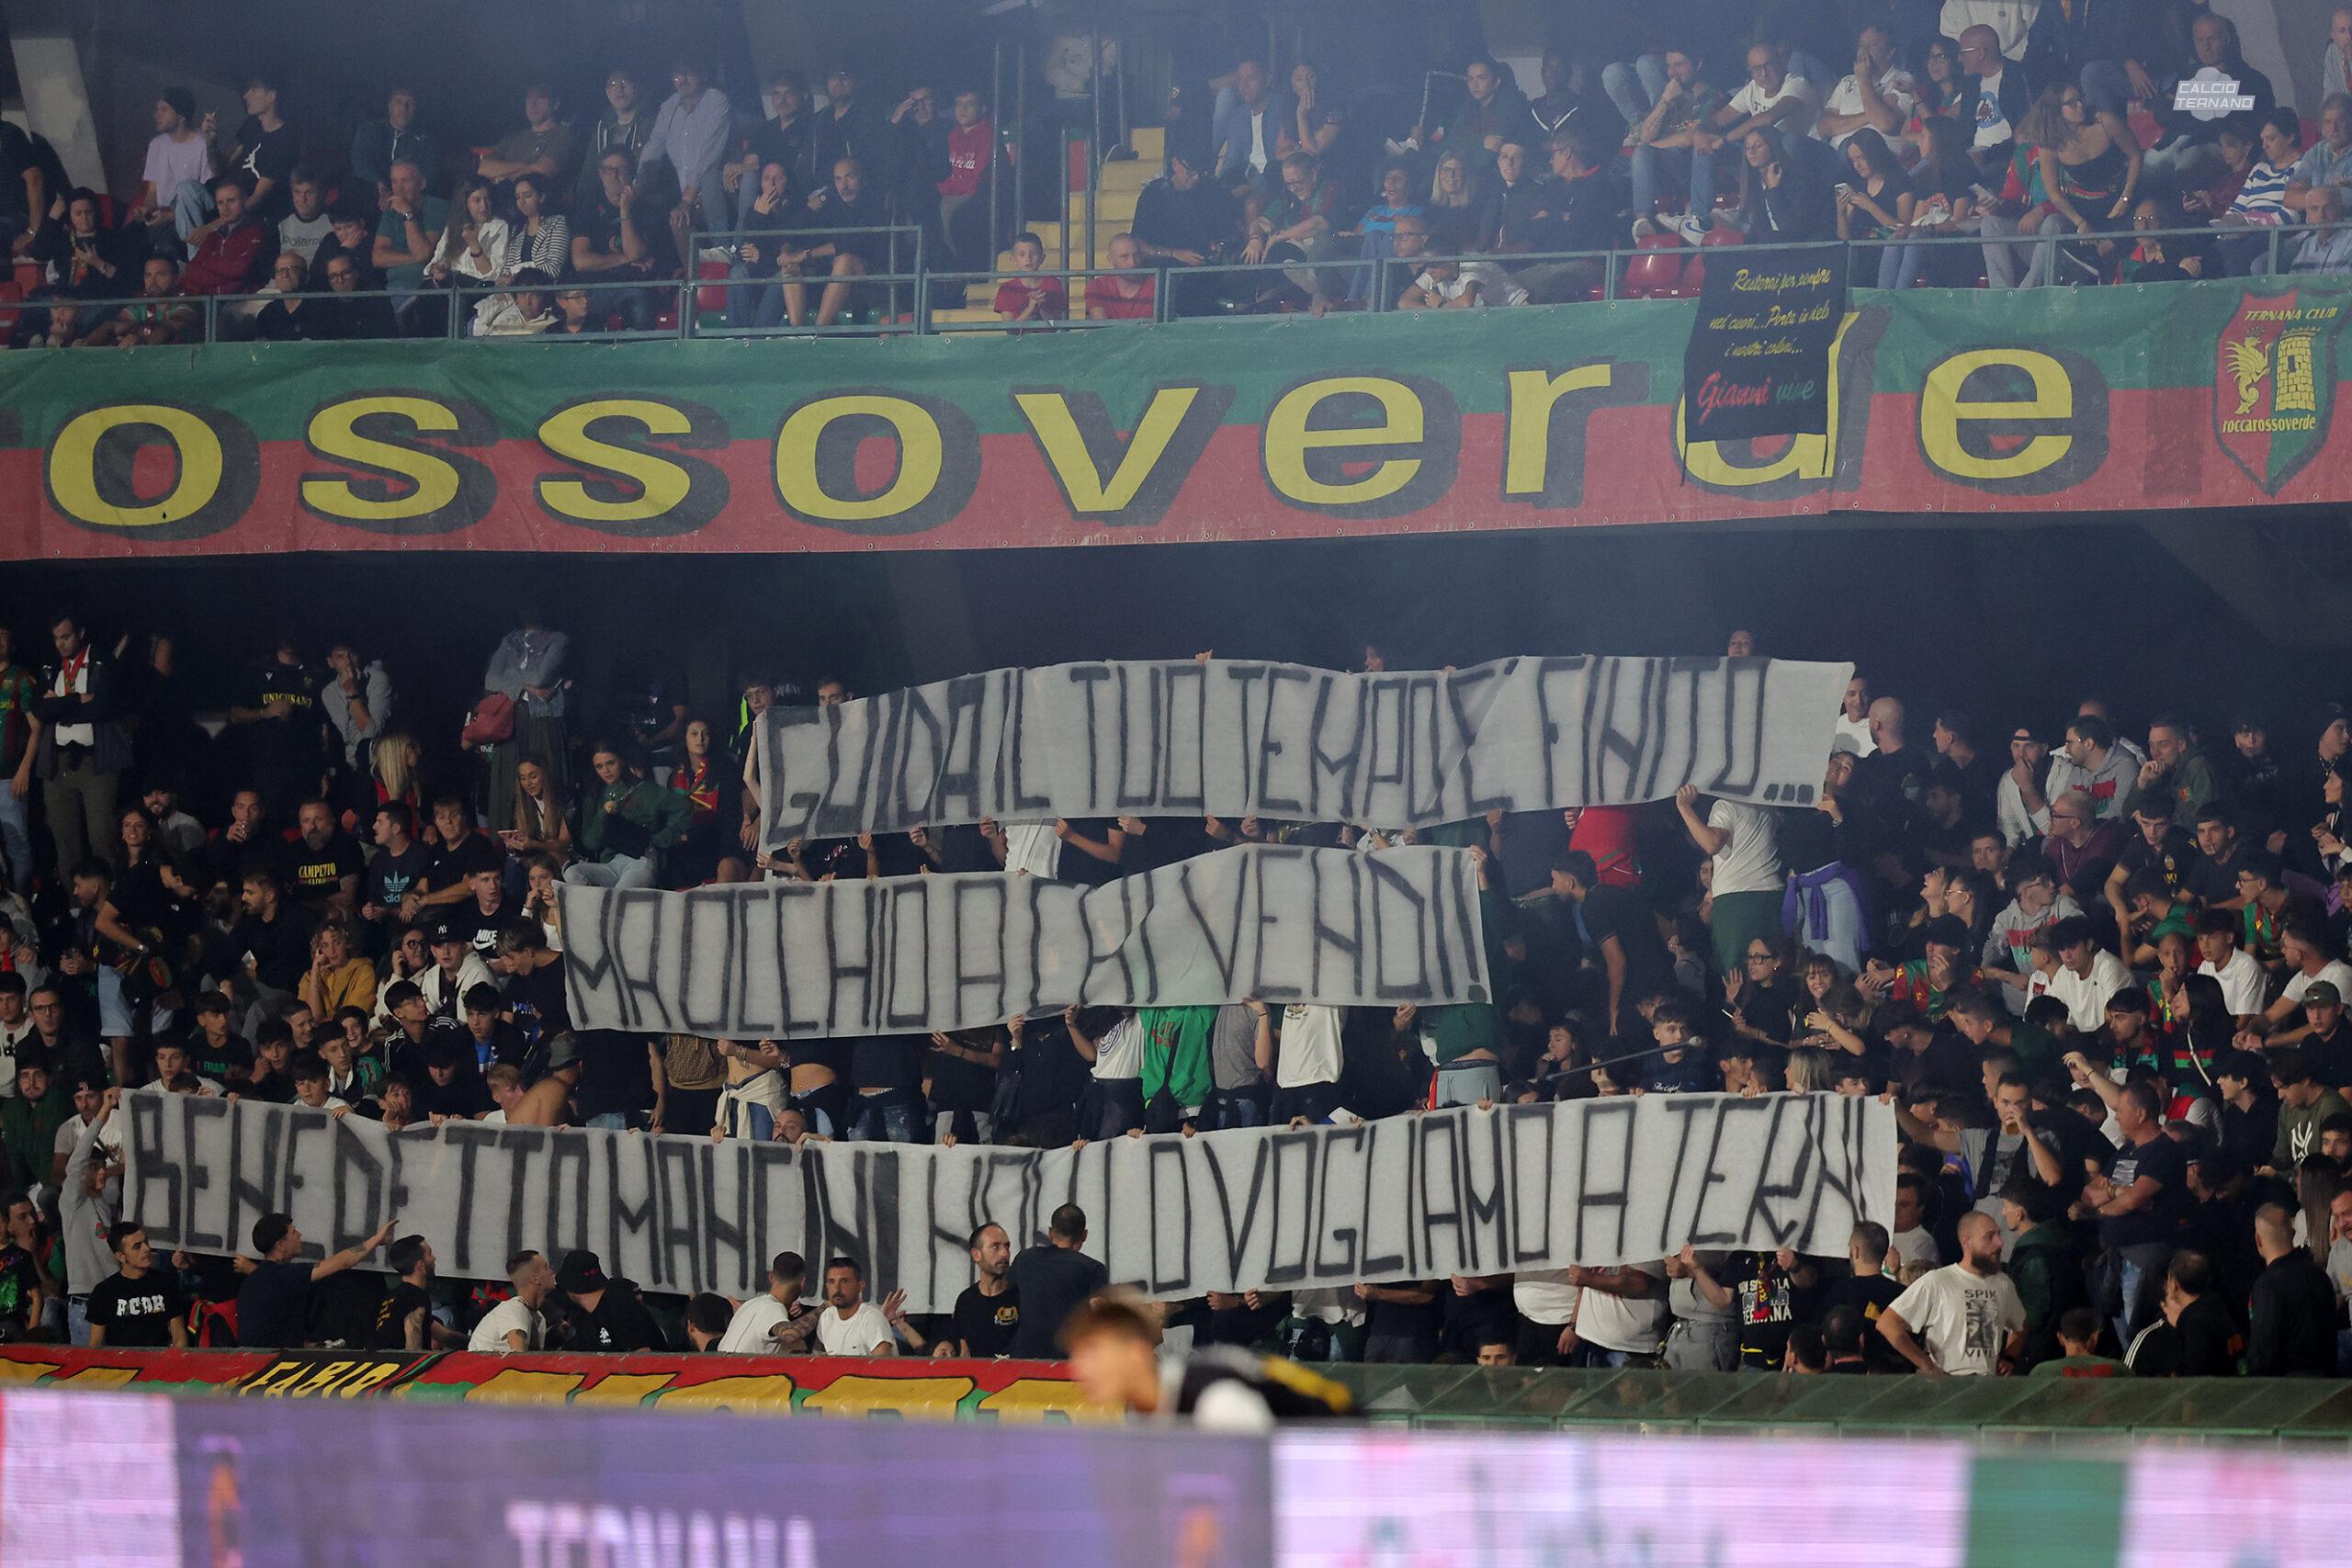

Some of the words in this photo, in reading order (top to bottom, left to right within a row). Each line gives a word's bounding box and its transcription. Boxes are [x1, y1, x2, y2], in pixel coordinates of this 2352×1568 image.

[1778, 275, 1795, 296] per
[2245, 310, 2301, 321] TERNANA
[2305, 307, 2338, 320] CLUB
[1697, 371, 1772, 426] Gianni
[1776, 375, 1816, 402] vive
[2222, 414, 2316, 434] roccarossoverde
[765, 674, 985, 844] GUIDA
[994, 668, 1051, 812] IL
[1069, 665, 1206, 809] TUO
[1227, 665, 1444, 822] TEMPO
[476, 929, 498, 942] NIKE
[679, 880, 930, 1033] OCCHIO
[954, 877, 1007, 1026] A
[130, 1093, 589, 1271] BENEDETTO
[606, 1133, 899, 1305] MANCINI
[1203, 1104, 1555, 1290] VOGLIAMO
[1575, 1100, 1637, 1261] A
[1660, 1094, 1868, 1253] TERNI
[116, 1294, 165, 1316] ACAB
[238, 1361, 400, 1399] FABIO
